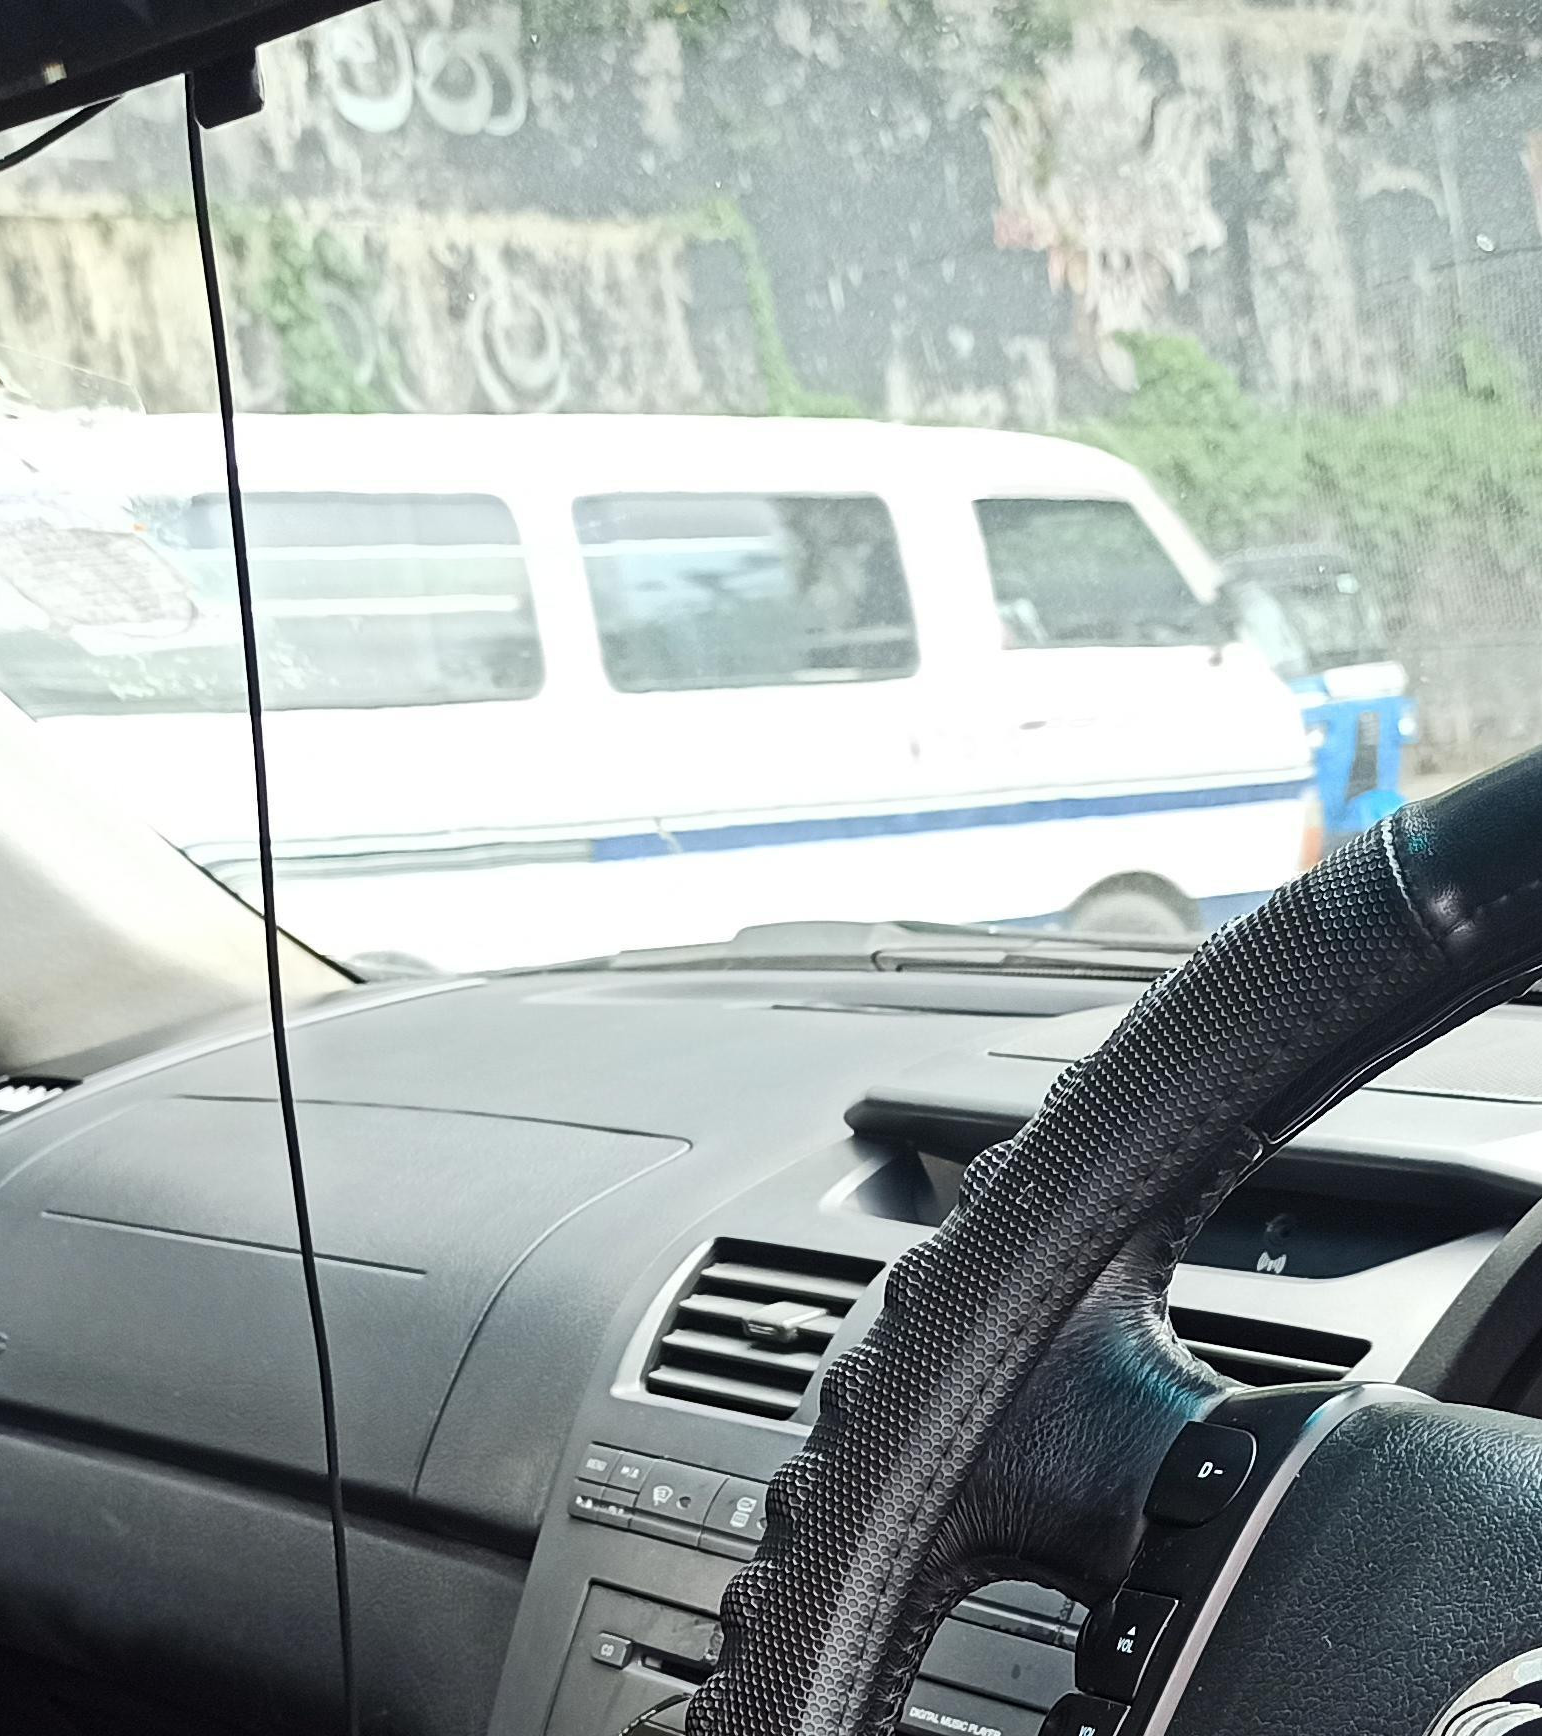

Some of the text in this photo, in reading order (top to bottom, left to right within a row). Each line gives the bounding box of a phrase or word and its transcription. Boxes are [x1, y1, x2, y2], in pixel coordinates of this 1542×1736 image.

[1116, 1636, 1135, 1655] VOL
[908, 1705, 939, 1724] DIGITAL
[940, 1714, 969, 1732] MUSIC
